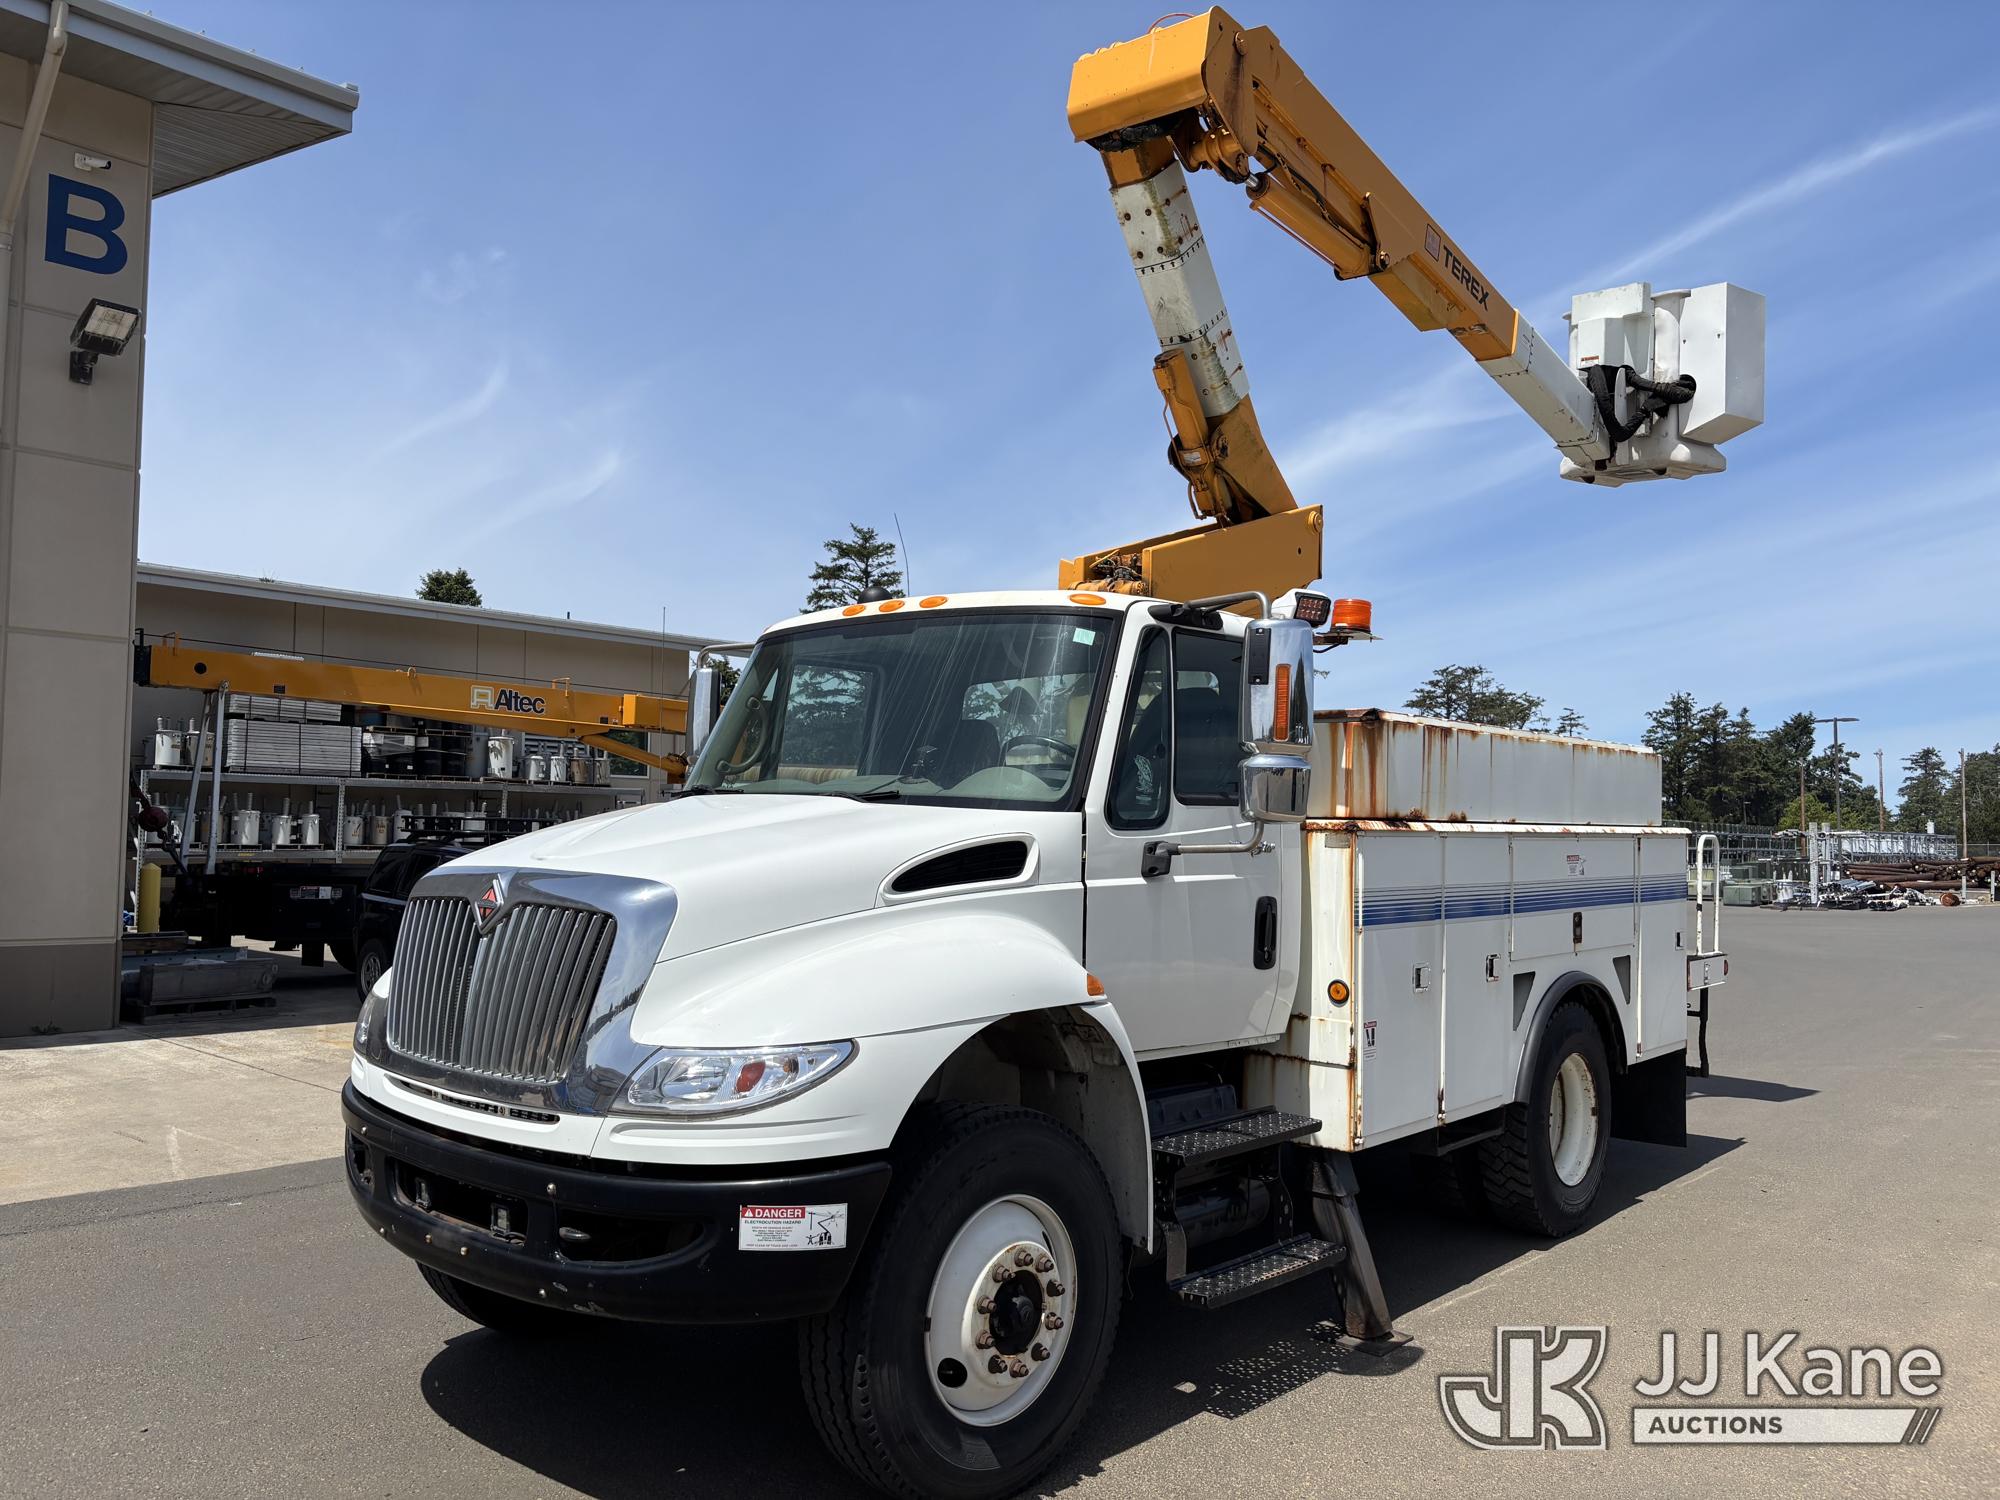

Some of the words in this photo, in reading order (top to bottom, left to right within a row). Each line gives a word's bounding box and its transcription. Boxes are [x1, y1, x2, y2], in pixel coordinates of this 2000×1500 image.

[45, 173, 128, 275] B
[1443, 244, 1489, 312] TEREX
[494, 688, 546, 714] Altec
[754, 1208, 803, 1218] DANGER
